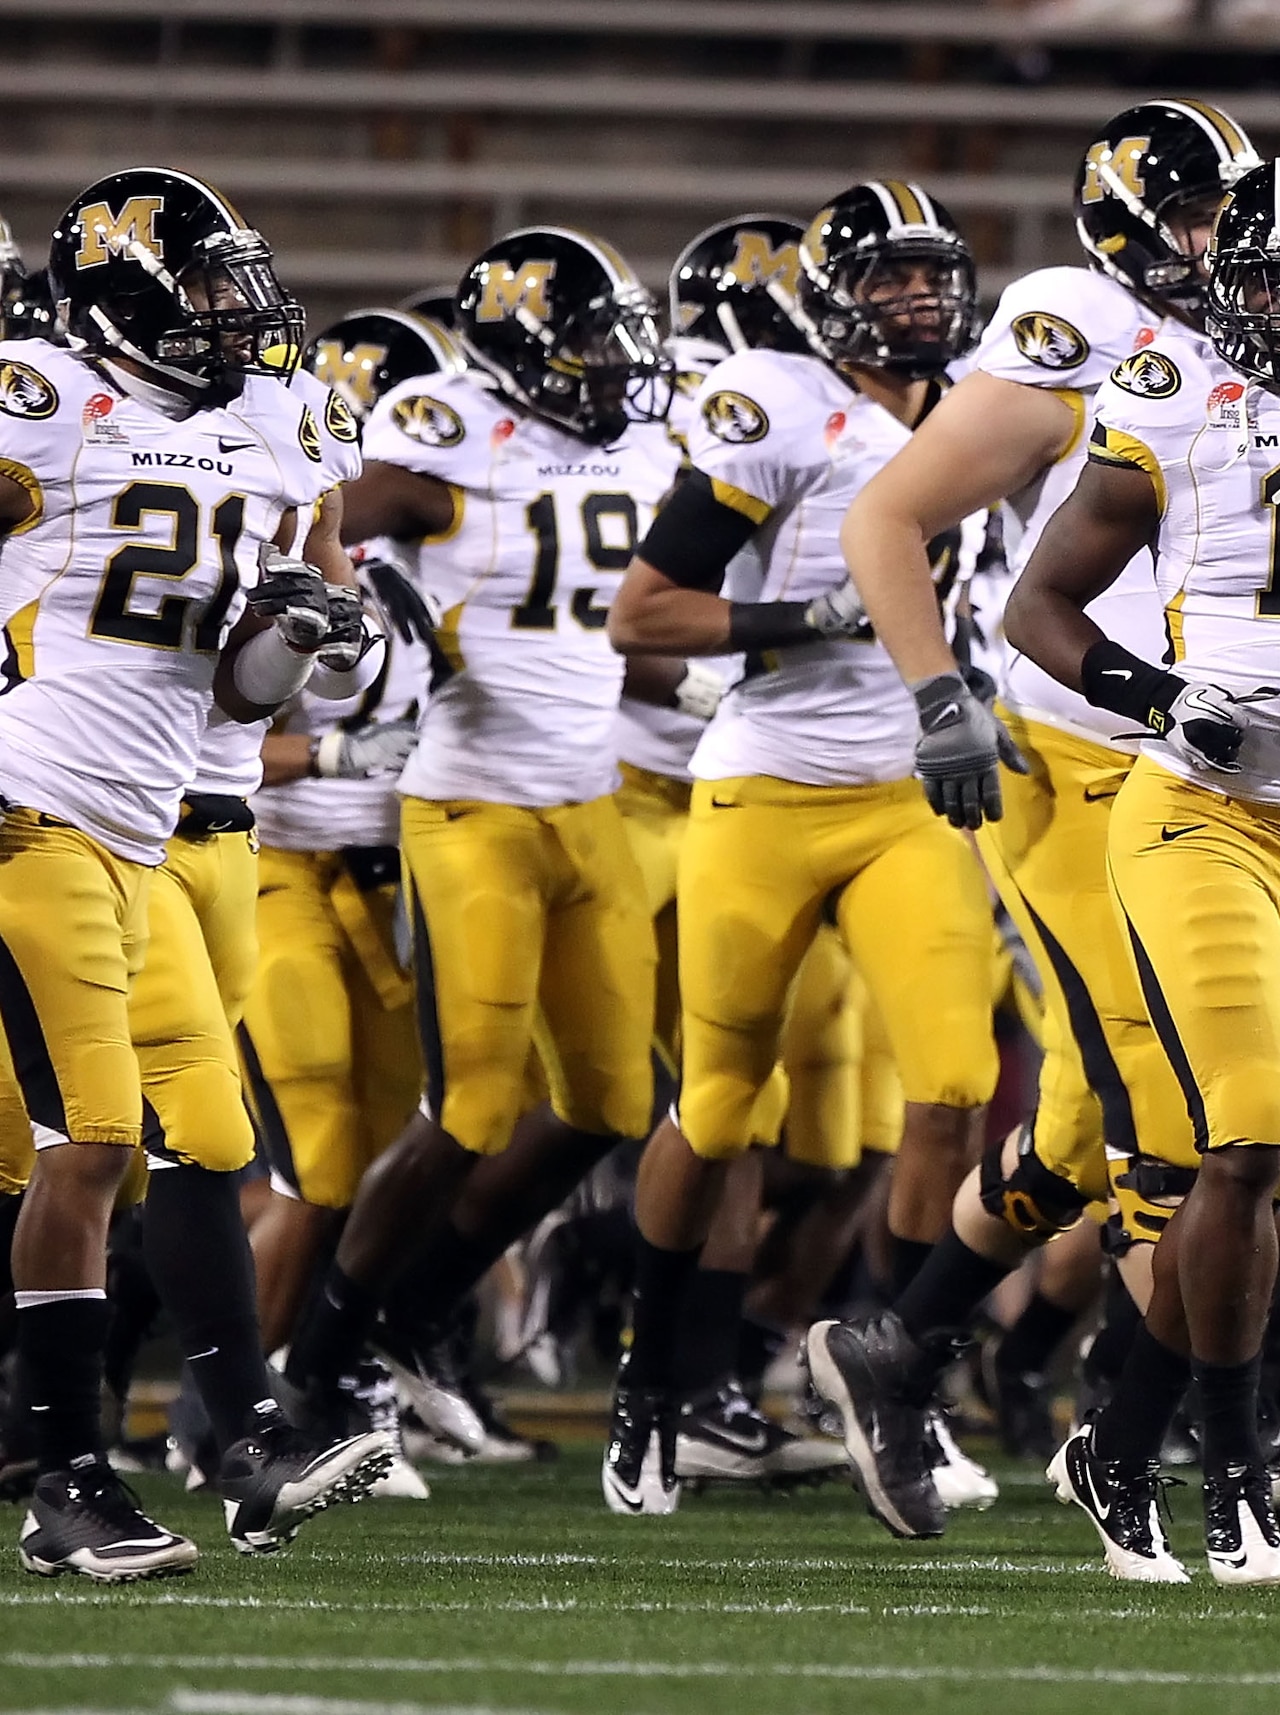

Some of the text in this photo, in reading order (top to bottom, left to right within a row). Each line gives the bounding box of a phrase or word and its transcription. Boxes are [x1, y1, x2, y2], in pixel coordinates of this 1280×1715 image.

[1082, 136, 1151, 205] M
[75, 196, 164, 270] M
[476, 259, 557, 323] M
[314, 340, 388, 406] M
[131, 452, 233, 476] MIZZOU
[537, 464, 620, 476] MIZZOU
[86, 479, 248, 655] 21
[509, 490, 638, 632] 19
